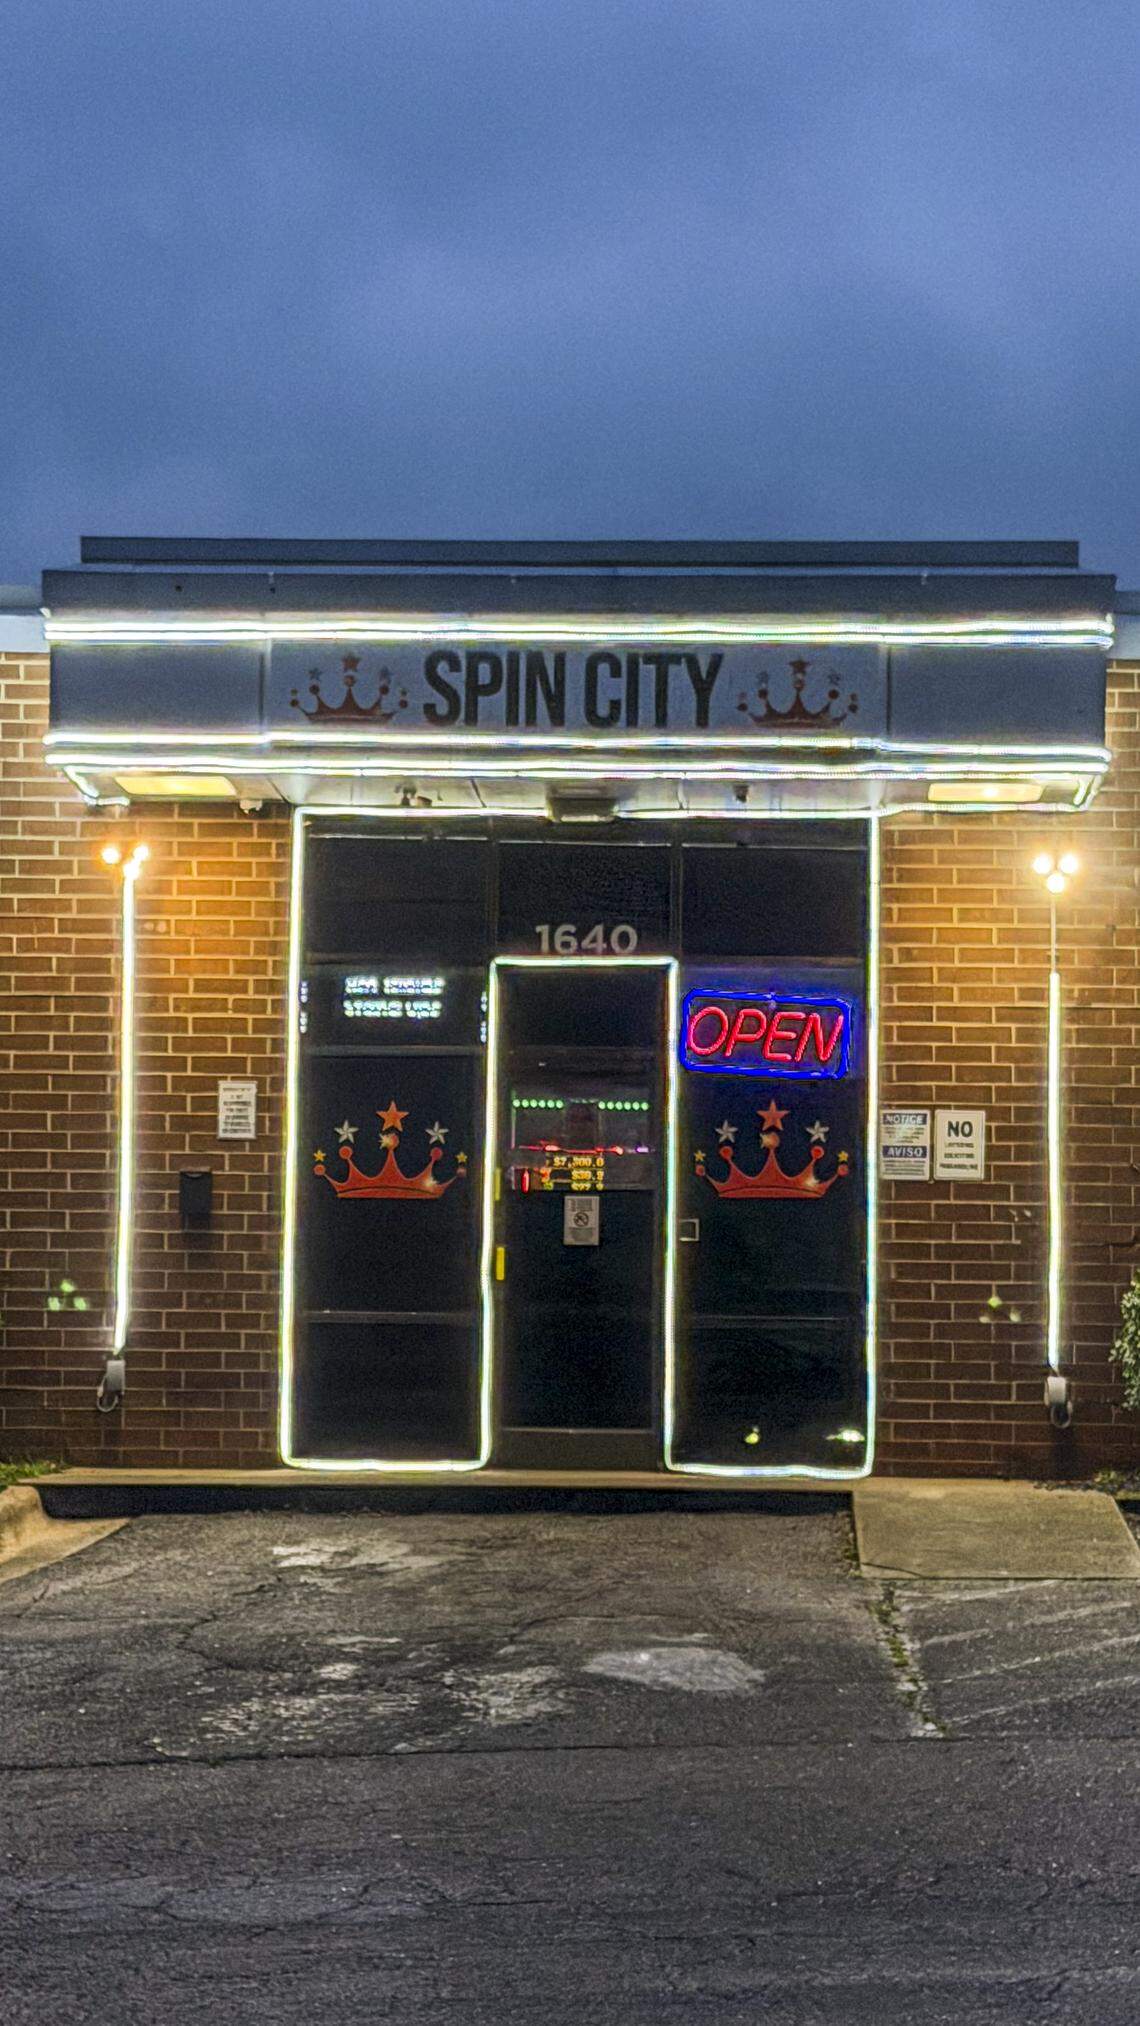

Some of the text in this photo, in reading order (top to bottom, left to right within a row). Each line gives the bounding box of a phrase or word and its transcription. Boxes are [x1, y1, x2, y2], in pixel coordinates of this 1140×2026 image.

[423, 651, 725, 729] SPIN CITY
[535, 924, 638, 955] 1640
[687, 1006, 844, 1062] OPEN
[885, 1114, 924, 1125] NOTICE
[947, 1121, 973, 1138] NO
[886, 1146, 923, 1157] AVISO
